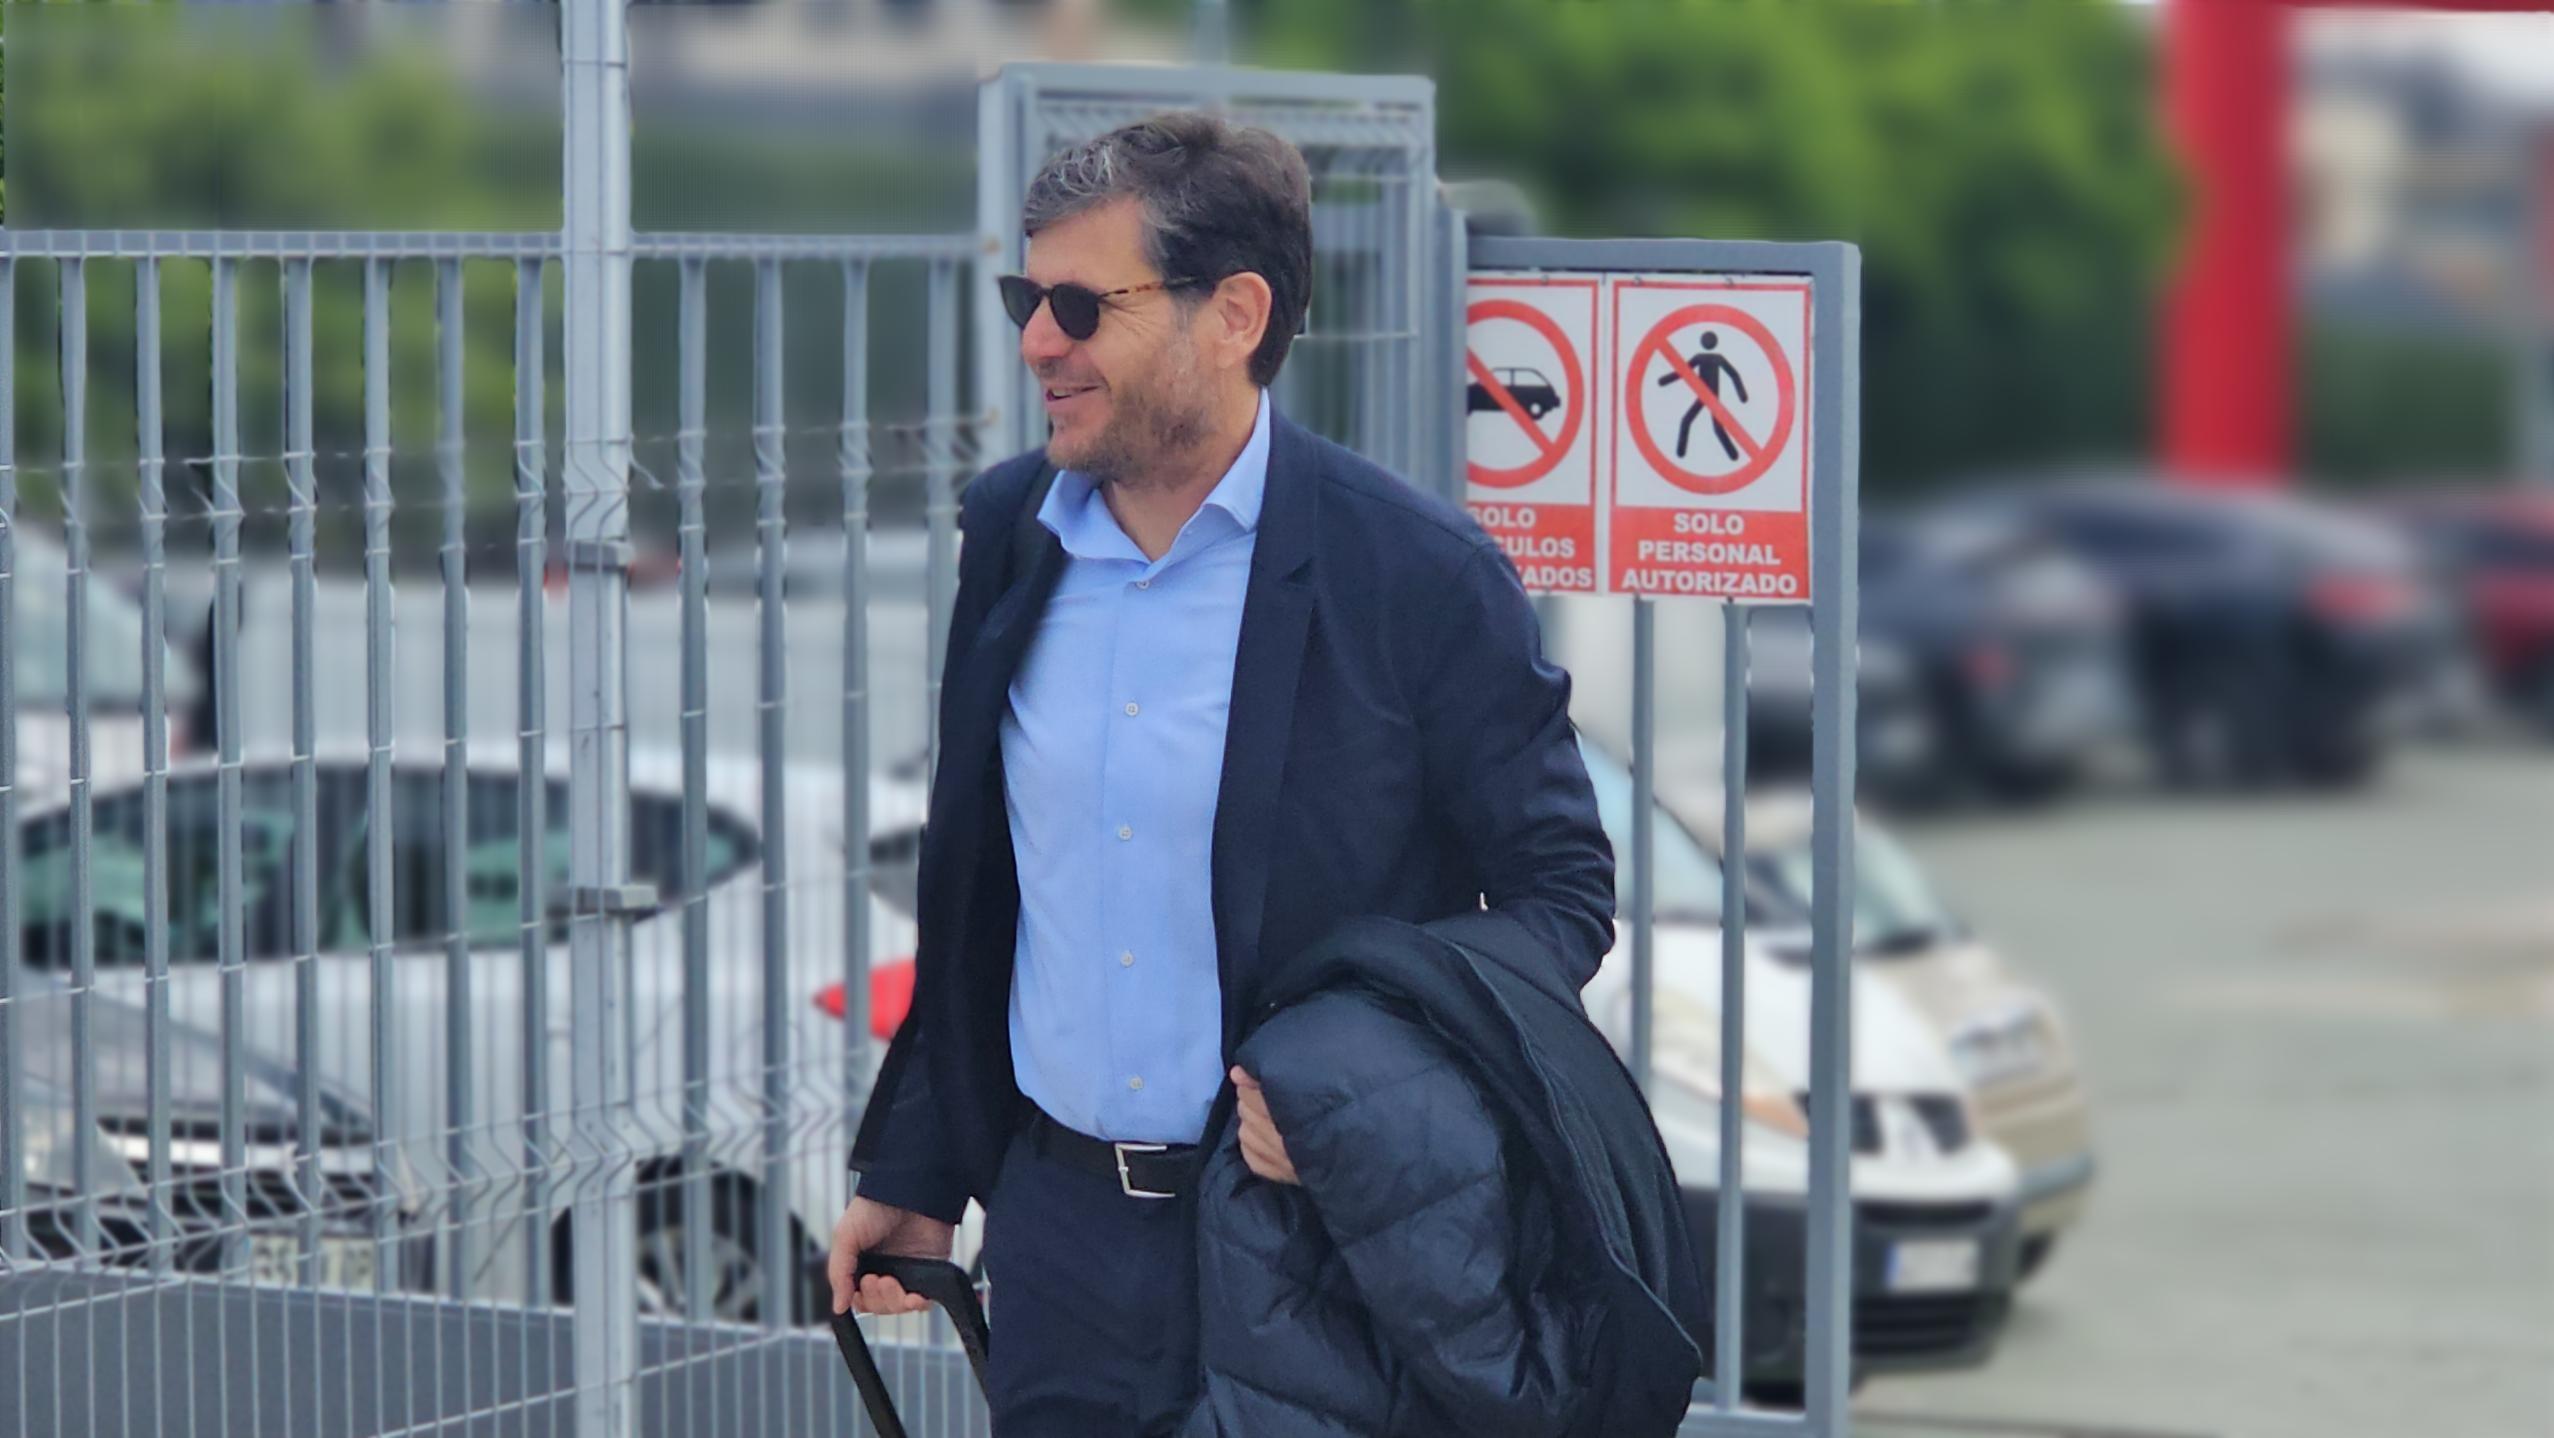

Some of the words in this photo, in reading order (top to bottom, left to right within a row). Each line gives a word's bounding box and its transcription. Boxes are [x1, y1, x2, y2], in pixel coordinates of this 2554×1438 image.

[1674, 512, 1745, 535] SOLO
[1638, 540, 1781, 566] PERSONAL
[1621, 568, 1798, 595] AUTORIZADO
